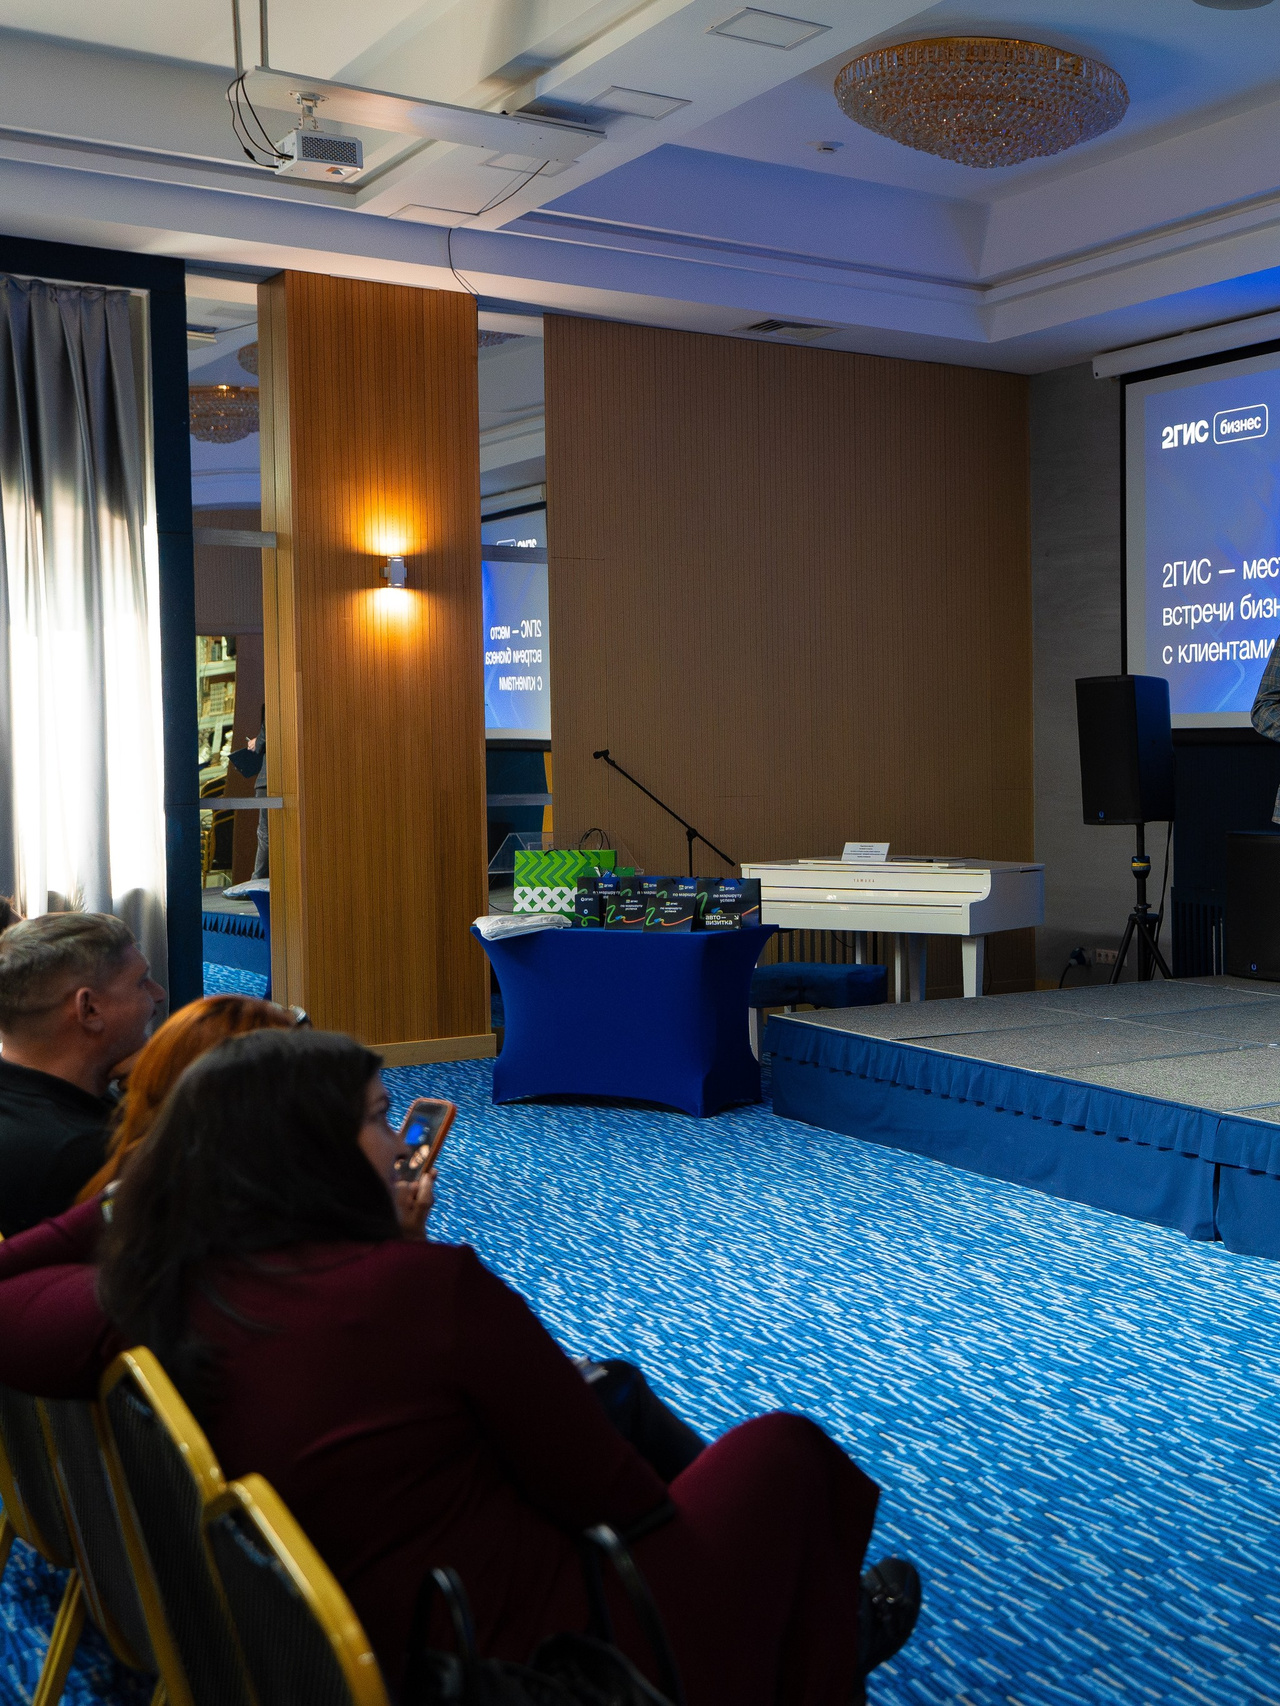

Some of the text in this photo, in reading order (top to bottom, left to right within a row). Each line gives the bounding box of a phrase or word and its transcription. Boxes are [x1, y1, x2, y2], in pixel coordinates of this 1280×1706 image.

[1161, 415, 1262, 450] 2ГИС бизнес
[1162, 558, 1212, 588] 2ГИС
[1162, 601, 1234, 630] встречи
[1162, 638, 1276, 665] с клиентами
